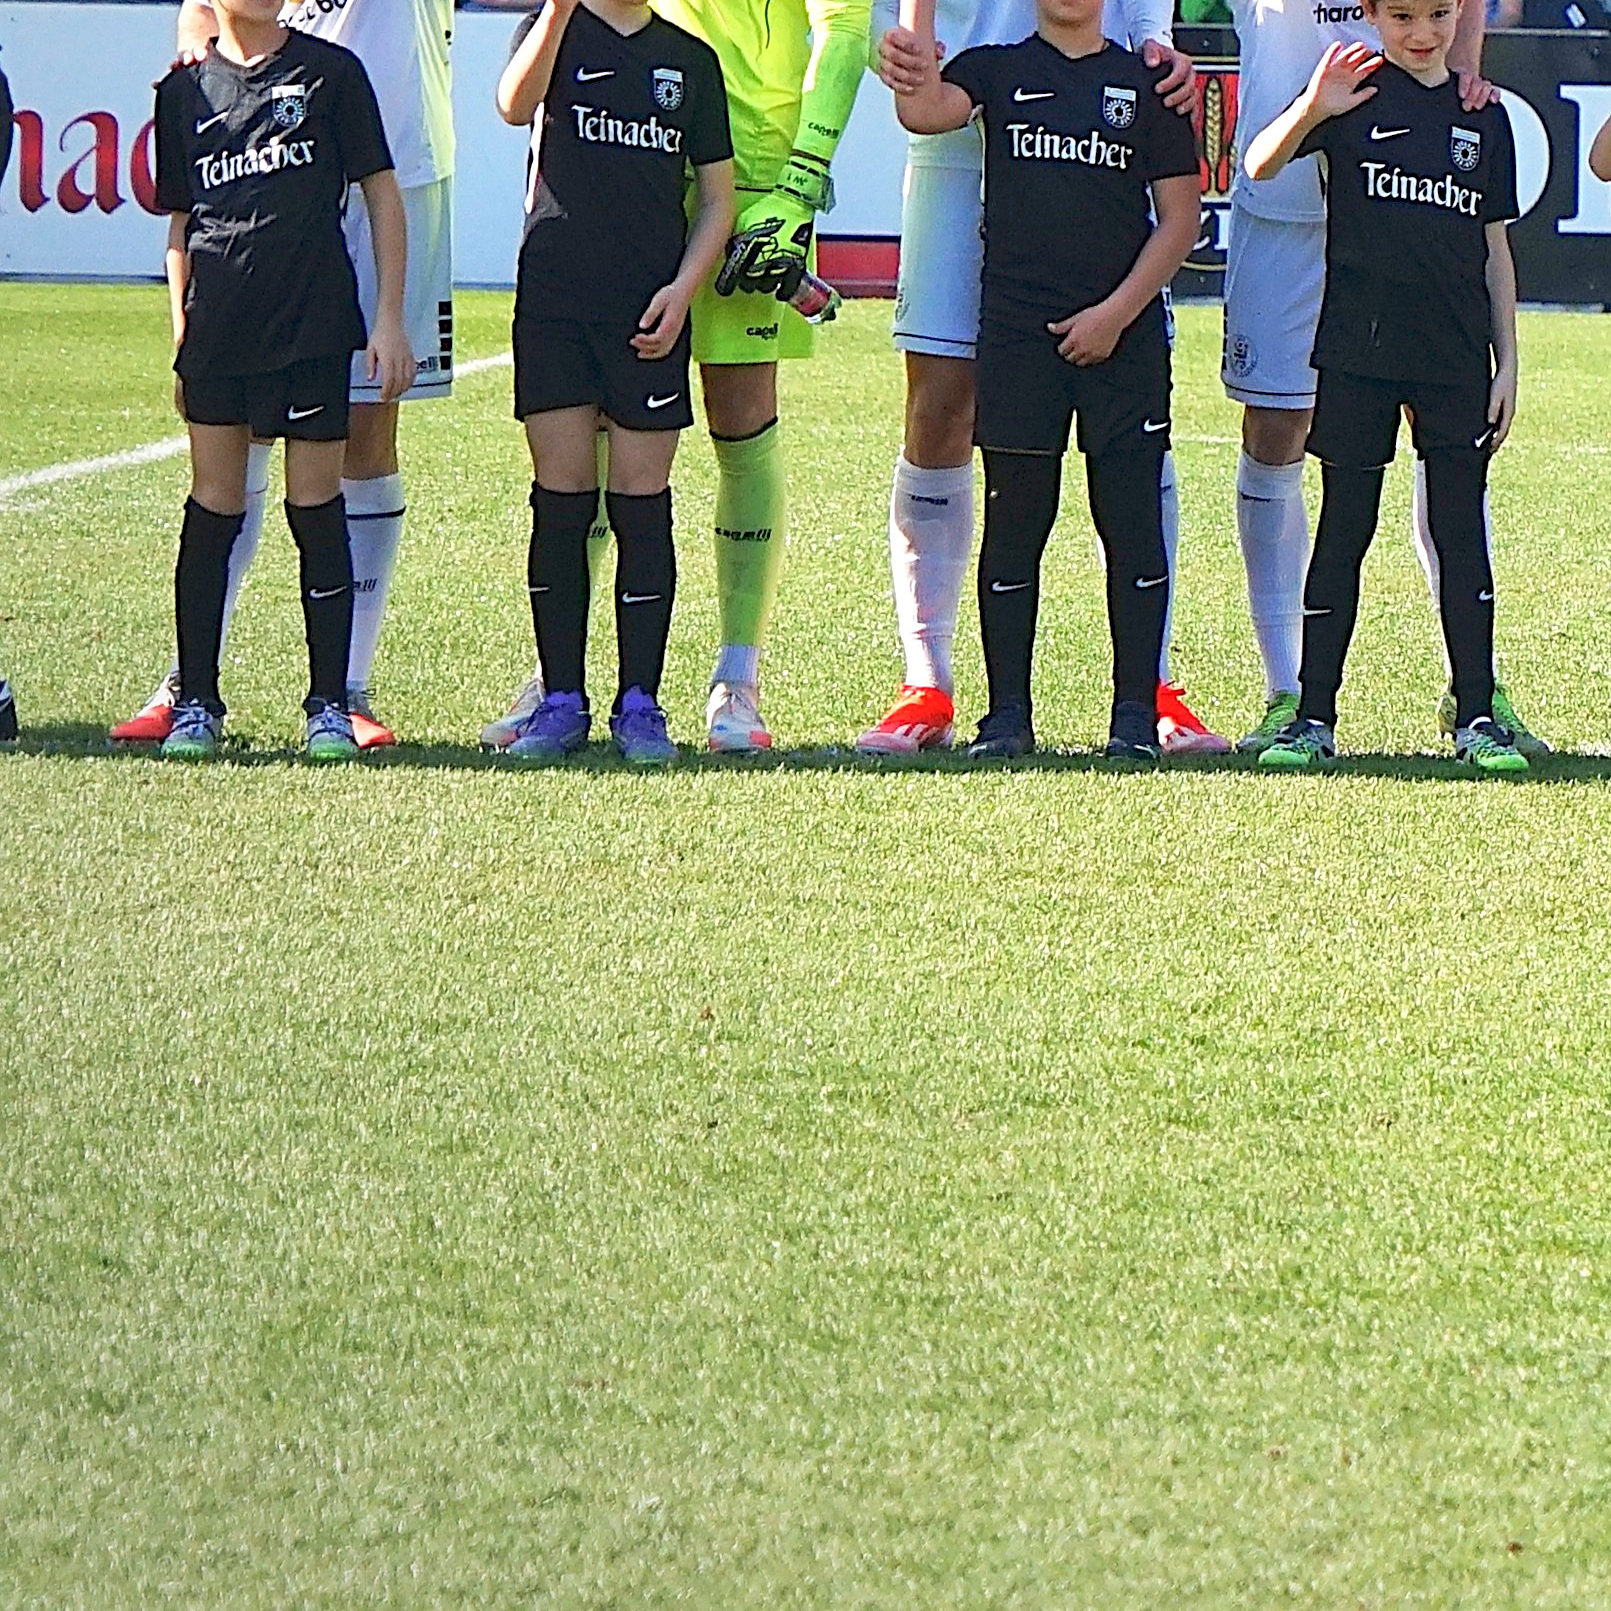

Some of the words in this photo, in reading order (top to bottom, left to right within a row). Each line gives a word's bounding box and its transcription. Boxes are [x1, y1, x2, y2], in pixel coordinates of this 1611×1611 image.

[194, 136, 315, 190] Teinacher
[1005, 123, 1133, 170] Teinacher
[1360, 161, 1483, 217] Teinacher
